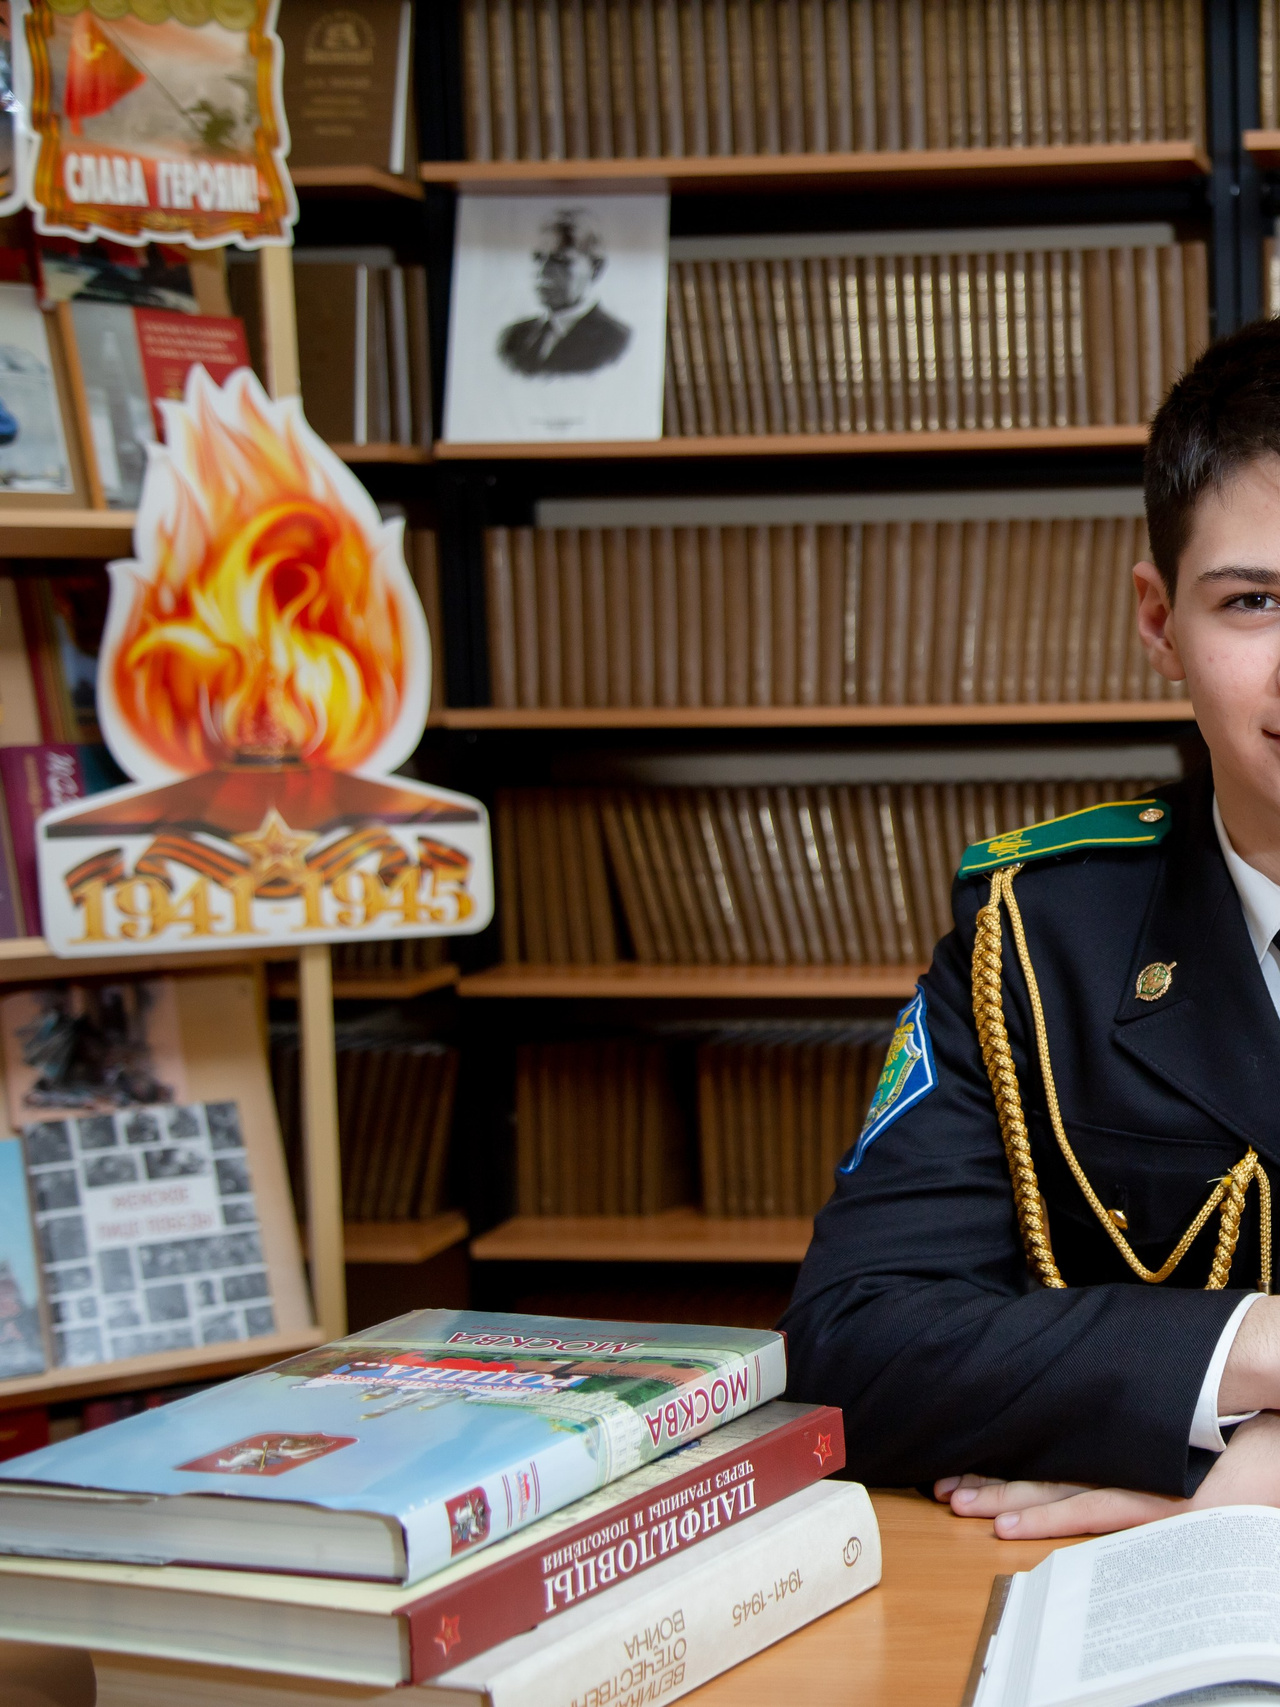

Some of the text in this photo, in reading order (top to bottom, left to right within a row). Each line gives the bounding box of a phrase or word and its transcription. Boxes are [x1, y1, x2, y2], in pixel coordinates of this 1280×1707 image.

[64, 153, 261, 214] СЛАВА ГЕРОЯМ!
[67, 866, 475, 944] 1941-1945
[446, 1331, 645, 1354] МОСКВА
[644, 1366, 748, 1448] МОСКВА
[543, 1459, 754, 1574] ЧЕРЕЗ ГРАНИЦЫ И ПОКОЛЕНИЯ
[544, 1478, 757, 1613] ПАНФИЛОВЦЫ
[624, 1609, 686, 1661] ВОЙНА
